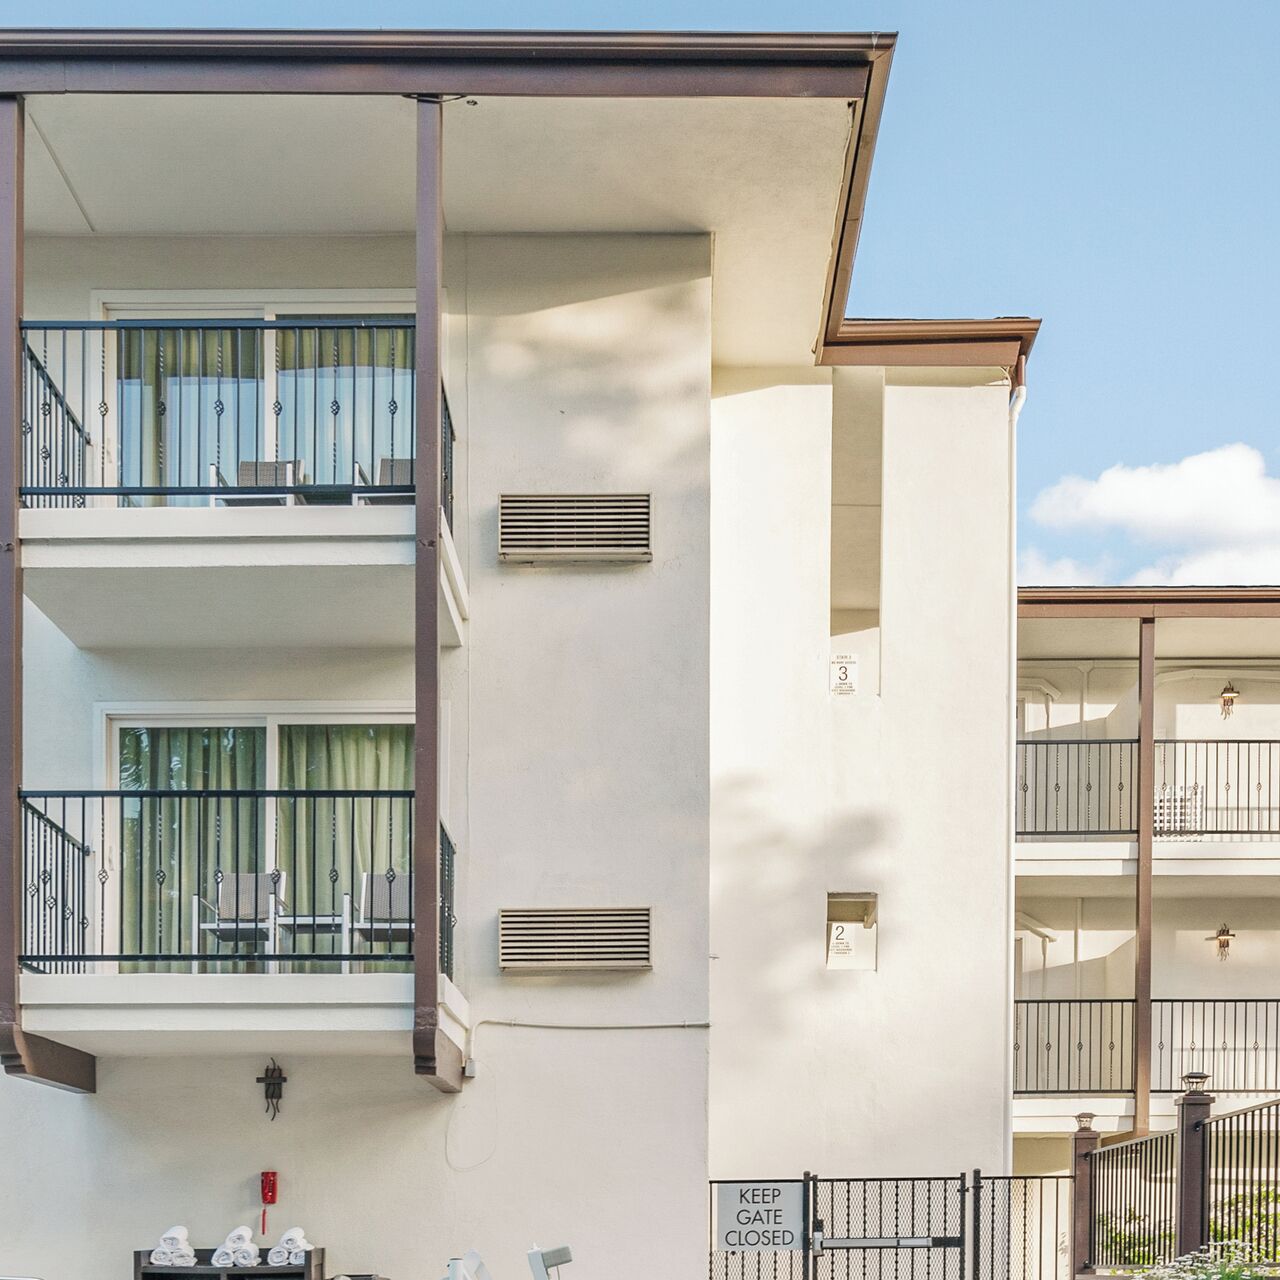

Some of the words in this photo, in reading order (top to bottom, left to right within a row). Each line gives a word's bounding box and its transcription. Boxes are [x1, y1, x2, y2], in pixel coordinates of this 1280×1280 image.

[838, 666, 848, 681] 3
[836, 926, 844, 940] 2
[740, 1188, 781, 1204] KEEP
[736, 1208, 782, 1225] GATE
[725, 1230, 794, 1246] CLOSED
